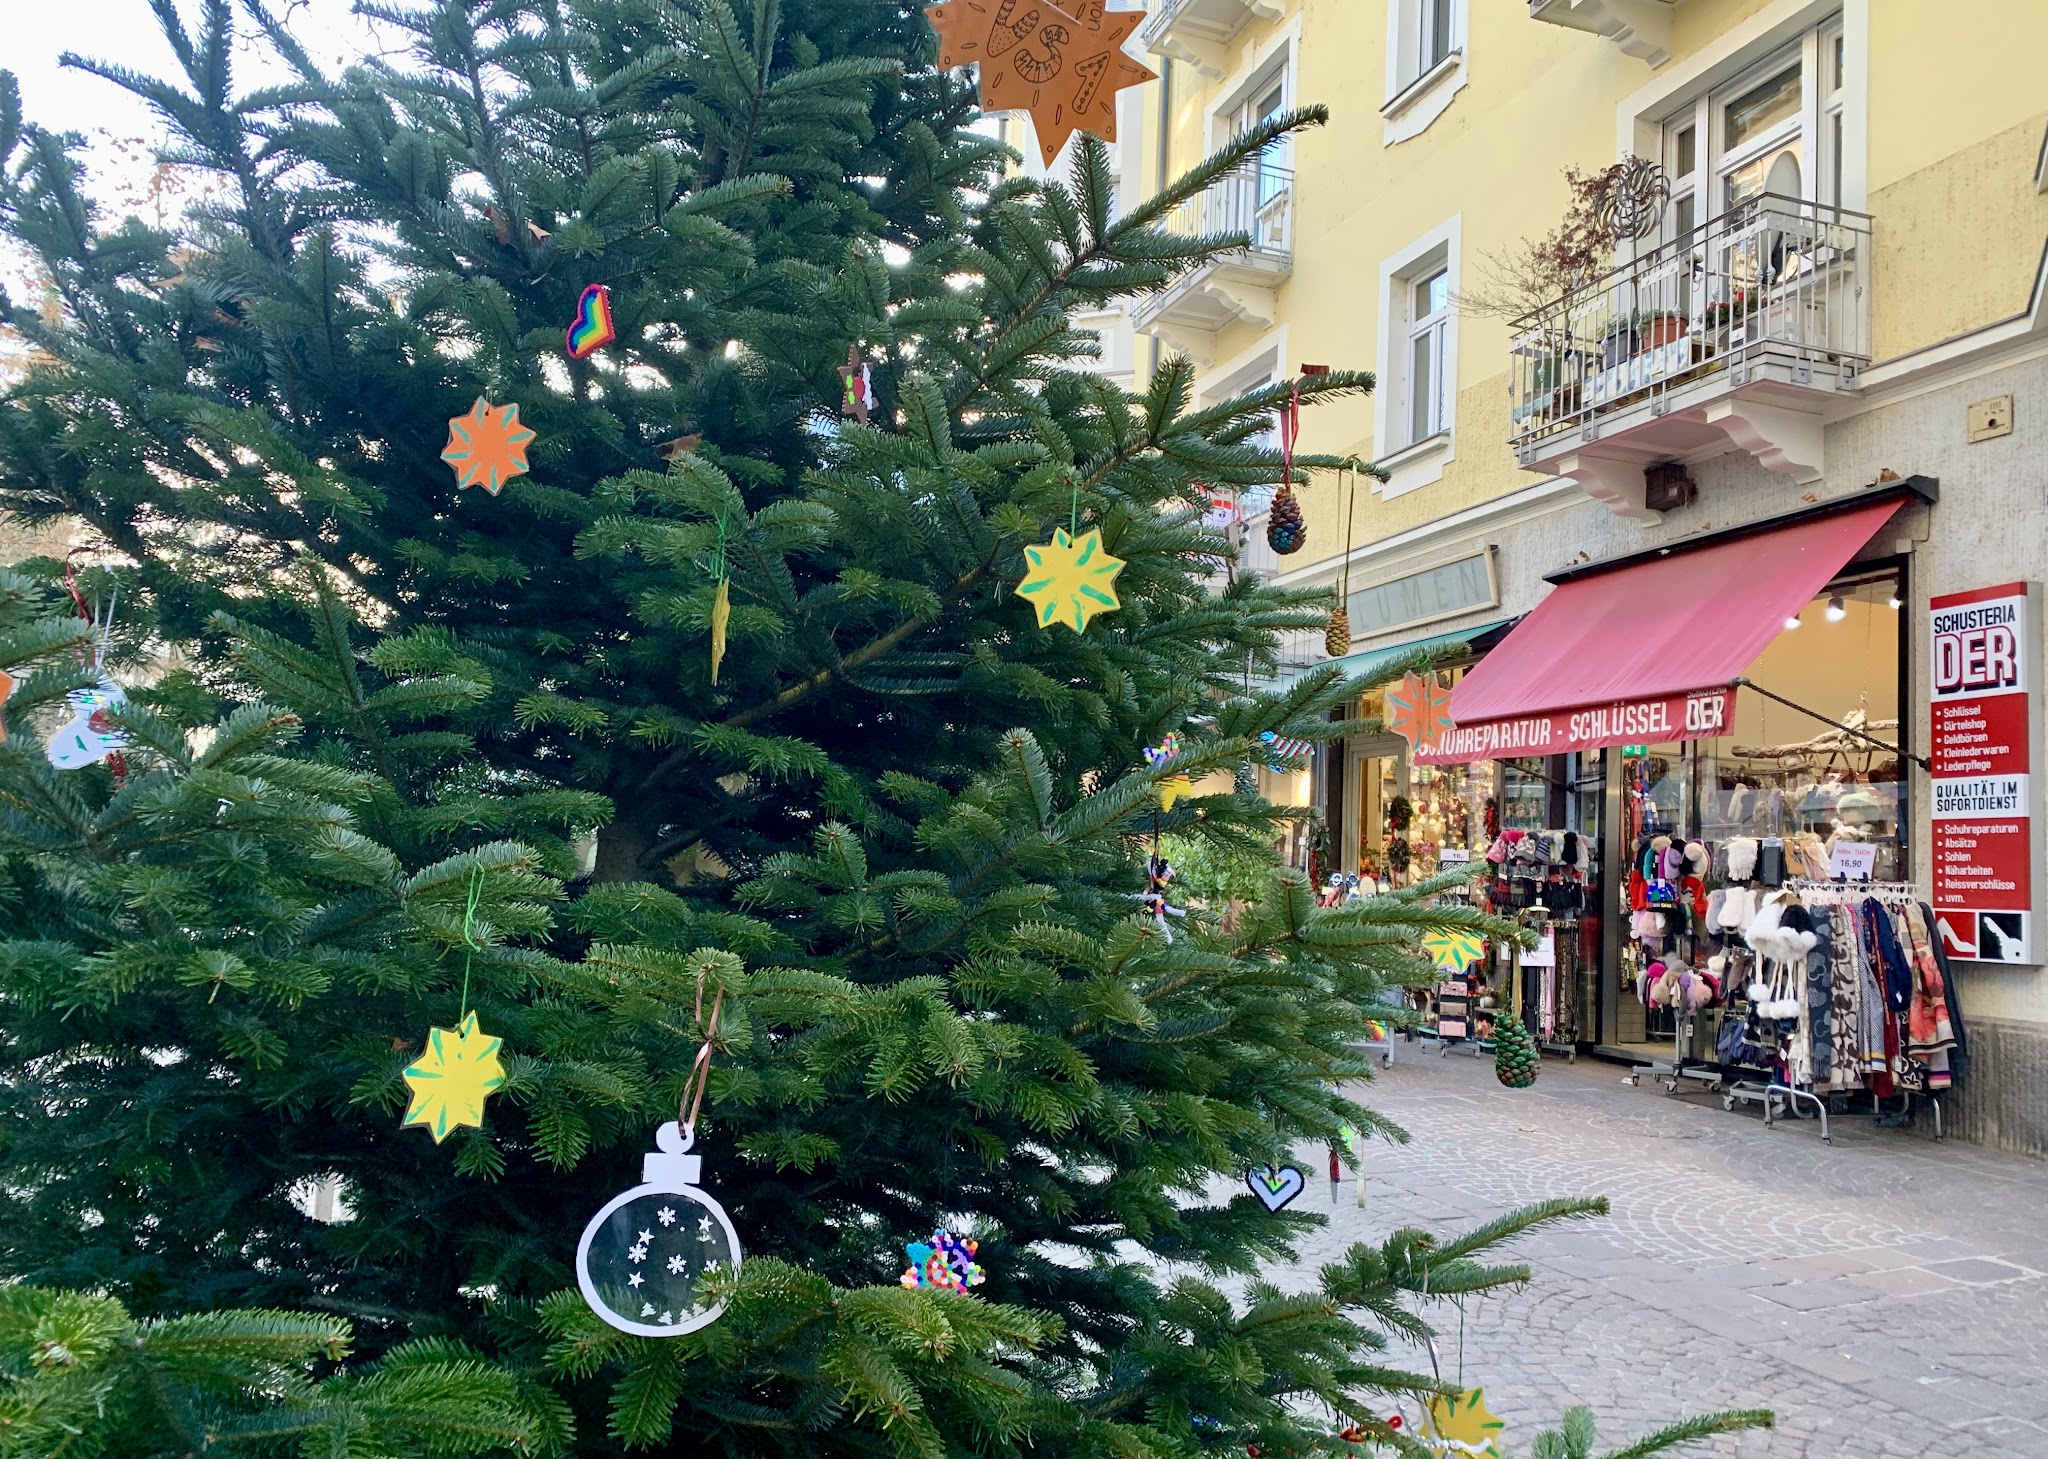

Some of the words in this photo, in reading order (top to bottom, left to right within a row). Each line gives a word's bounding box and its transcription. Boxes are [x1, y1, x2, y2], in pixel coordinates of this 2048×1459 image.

[1934, 604, 2016, 634] SCHUSTERIA
[1935, 625, 2017, 695] DER
[1685, 695, 1726, 733] DER
[1943, 705, 1981, 718] Schlüssel
[1569, 701, 1672, 743] SCHLÜSSEL
[1943, 719, 1987, 731] Gürtelshop
[1943, 733, 1989, 744] Geldbörsen
[1943, 745, 2010, 758] Kleinlederwaren
[1943, 759, 1992, 772] Lederpflege
[1936, 780, 1996, 798] QUALITÄT
[2002, 781, 2018, 795] IM
[1937, 796, 2018, 812] SOFORTDIENST
[1944, 824, 2019, 836] Schuhreparaturen
[1945, 838, 1977, 848] Absätze
[1945, 851, 1972, 862] Sohlen
[1840, 859, 1862, 868] 16,90
[1945, 865, 1994, 876] Näharbeiten
[1945, 878, 2016, 890] Reissverschlüsse
[1945, 894, 1966, 903] uvm.
